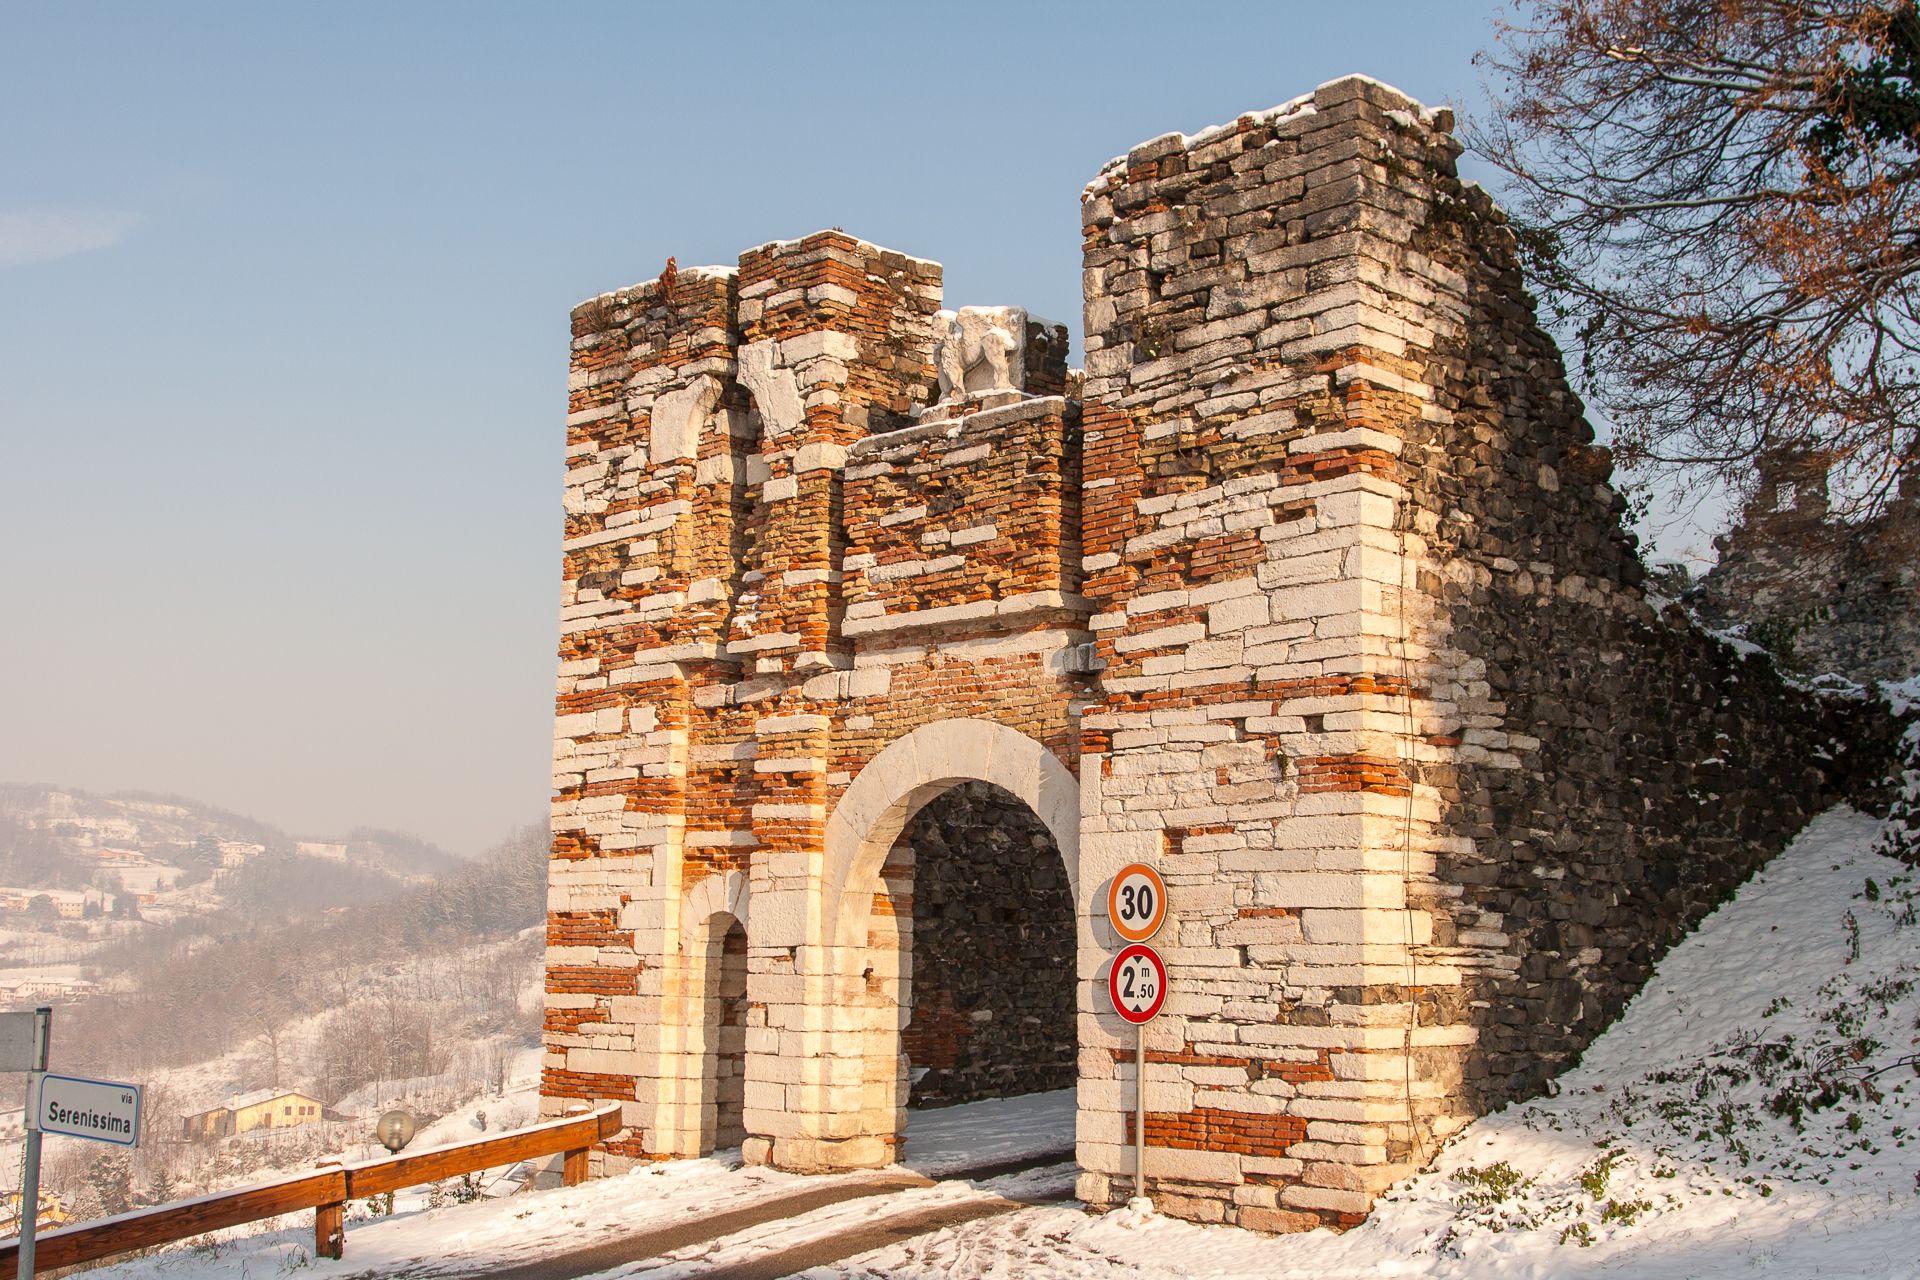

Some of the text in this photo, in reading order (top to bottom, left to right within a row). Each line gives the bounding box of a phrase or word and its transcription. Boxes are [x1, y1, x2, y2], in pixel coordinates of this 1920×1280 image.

[1121, 884, 1153, 920] 30
[121, 1093, 133, 1104] via
[48, 1101, 131, 1134] Serenissima
